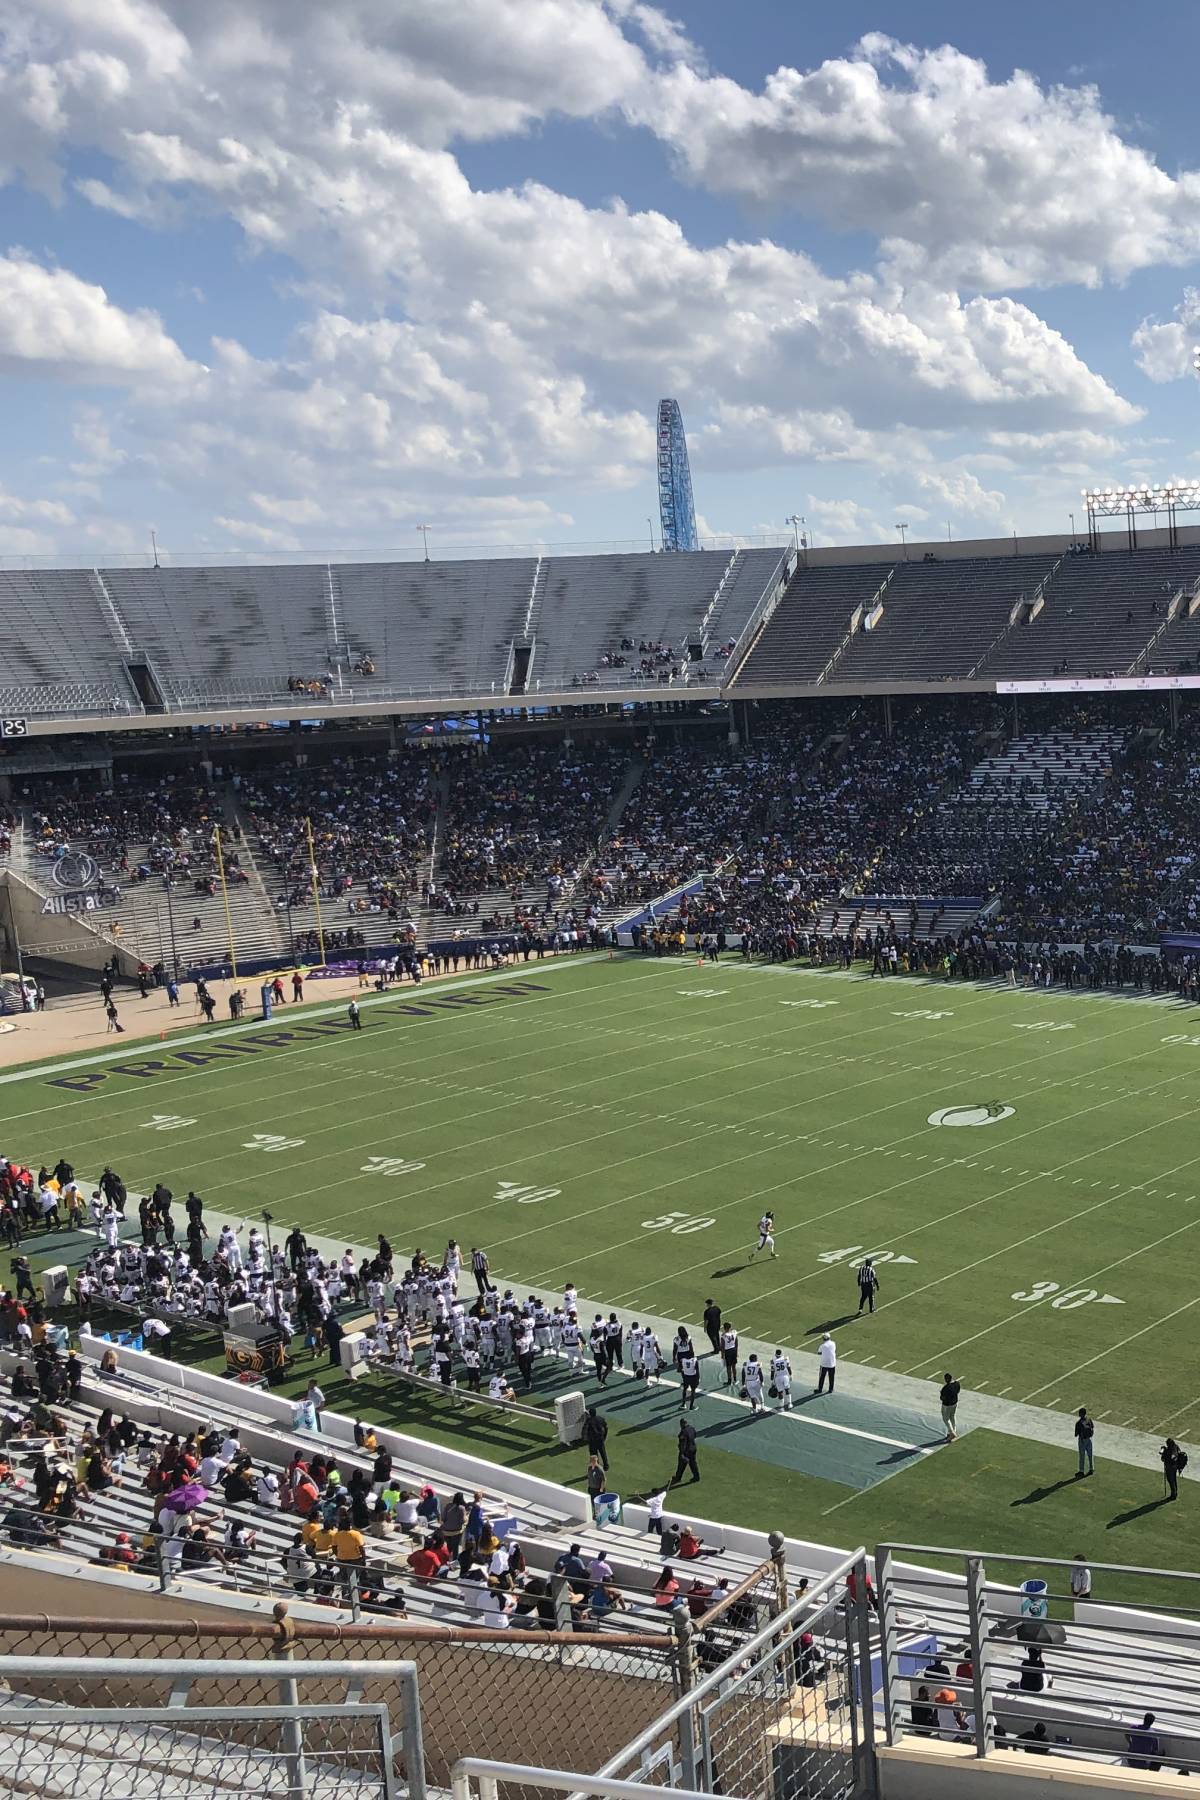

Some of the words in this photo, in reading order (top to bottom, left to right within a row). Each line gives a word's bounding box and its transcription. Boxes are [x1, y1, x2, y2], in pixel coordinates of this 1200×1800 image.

[4, 720, 25, 735] 25
[41, 890, 114, 914] Allstate
[42, 1016, 390, 1093] PRAIRIE
[371, 982, 554, 1018] VIEW
[360, 1157, 427, 1177] 30
[492, 1185, 563, 1204] 40
[640, 1211, 717, 1235] 50
[815, 1245, 896, 1269] 40
[1010, 1280, 1099, 1310] 30
[747, 1366, 756, 1376] 57
[775, 1361, 785, 1372] 56
